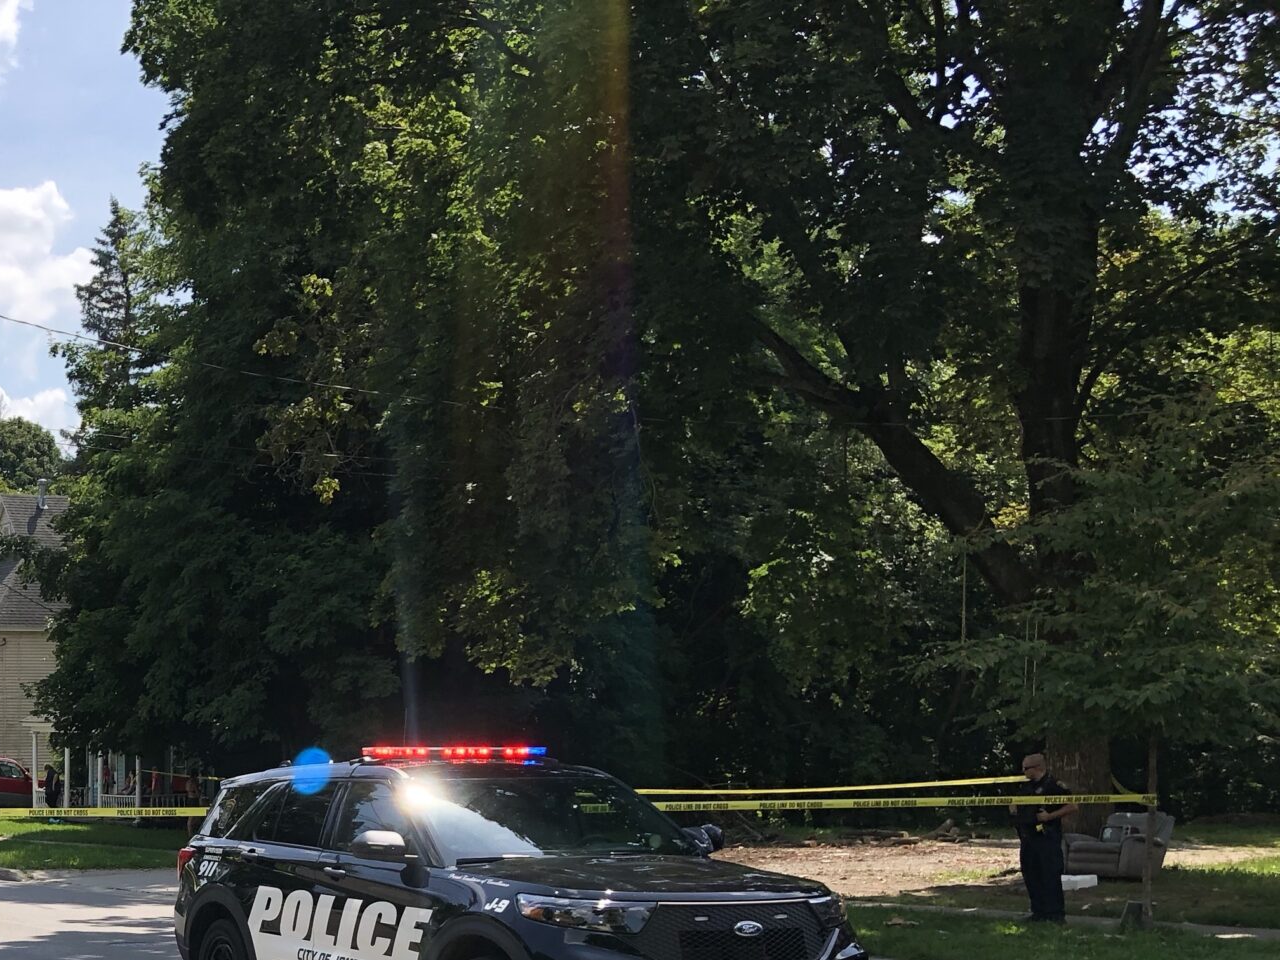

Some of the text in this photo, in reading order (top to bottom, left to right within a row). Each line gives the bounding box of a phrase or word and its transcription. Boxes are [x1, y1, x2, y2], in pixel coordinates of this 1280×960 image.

[198, 860, 218, 876] 911
[484, 898, 510, 913] J-9
[248, 885, 432, 957] POLICE
